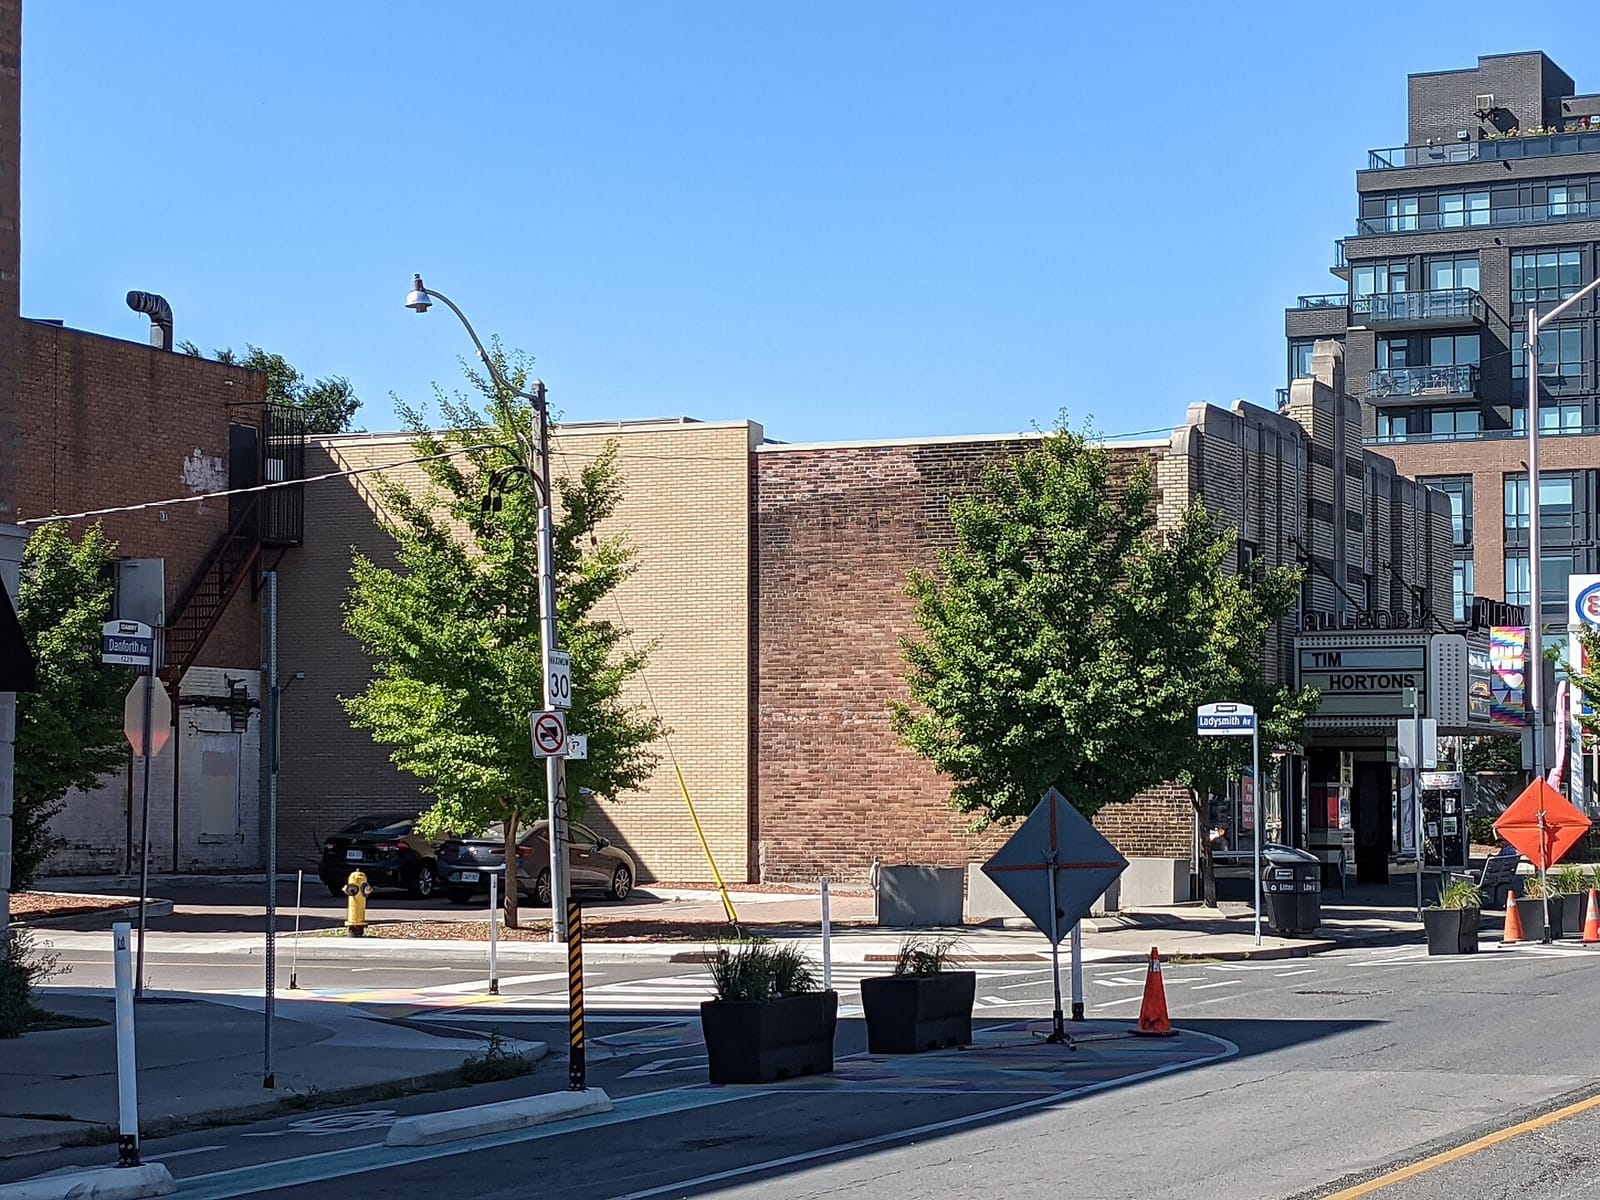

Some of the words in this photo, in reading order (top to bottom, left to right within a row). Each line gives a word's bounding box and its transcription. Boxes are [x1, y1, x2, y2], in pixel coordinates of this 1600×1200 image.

[1303, 607, 1427, 631] ALLENBY
[109, 638, 139, 653] Danforth
[1312, 652, 1342, 667] TIM
[551, 672, 569, 699] 30
[1329, 674, 1416, 689] HORTONS
[1200, 716, 1240, 728] Ladysmith
